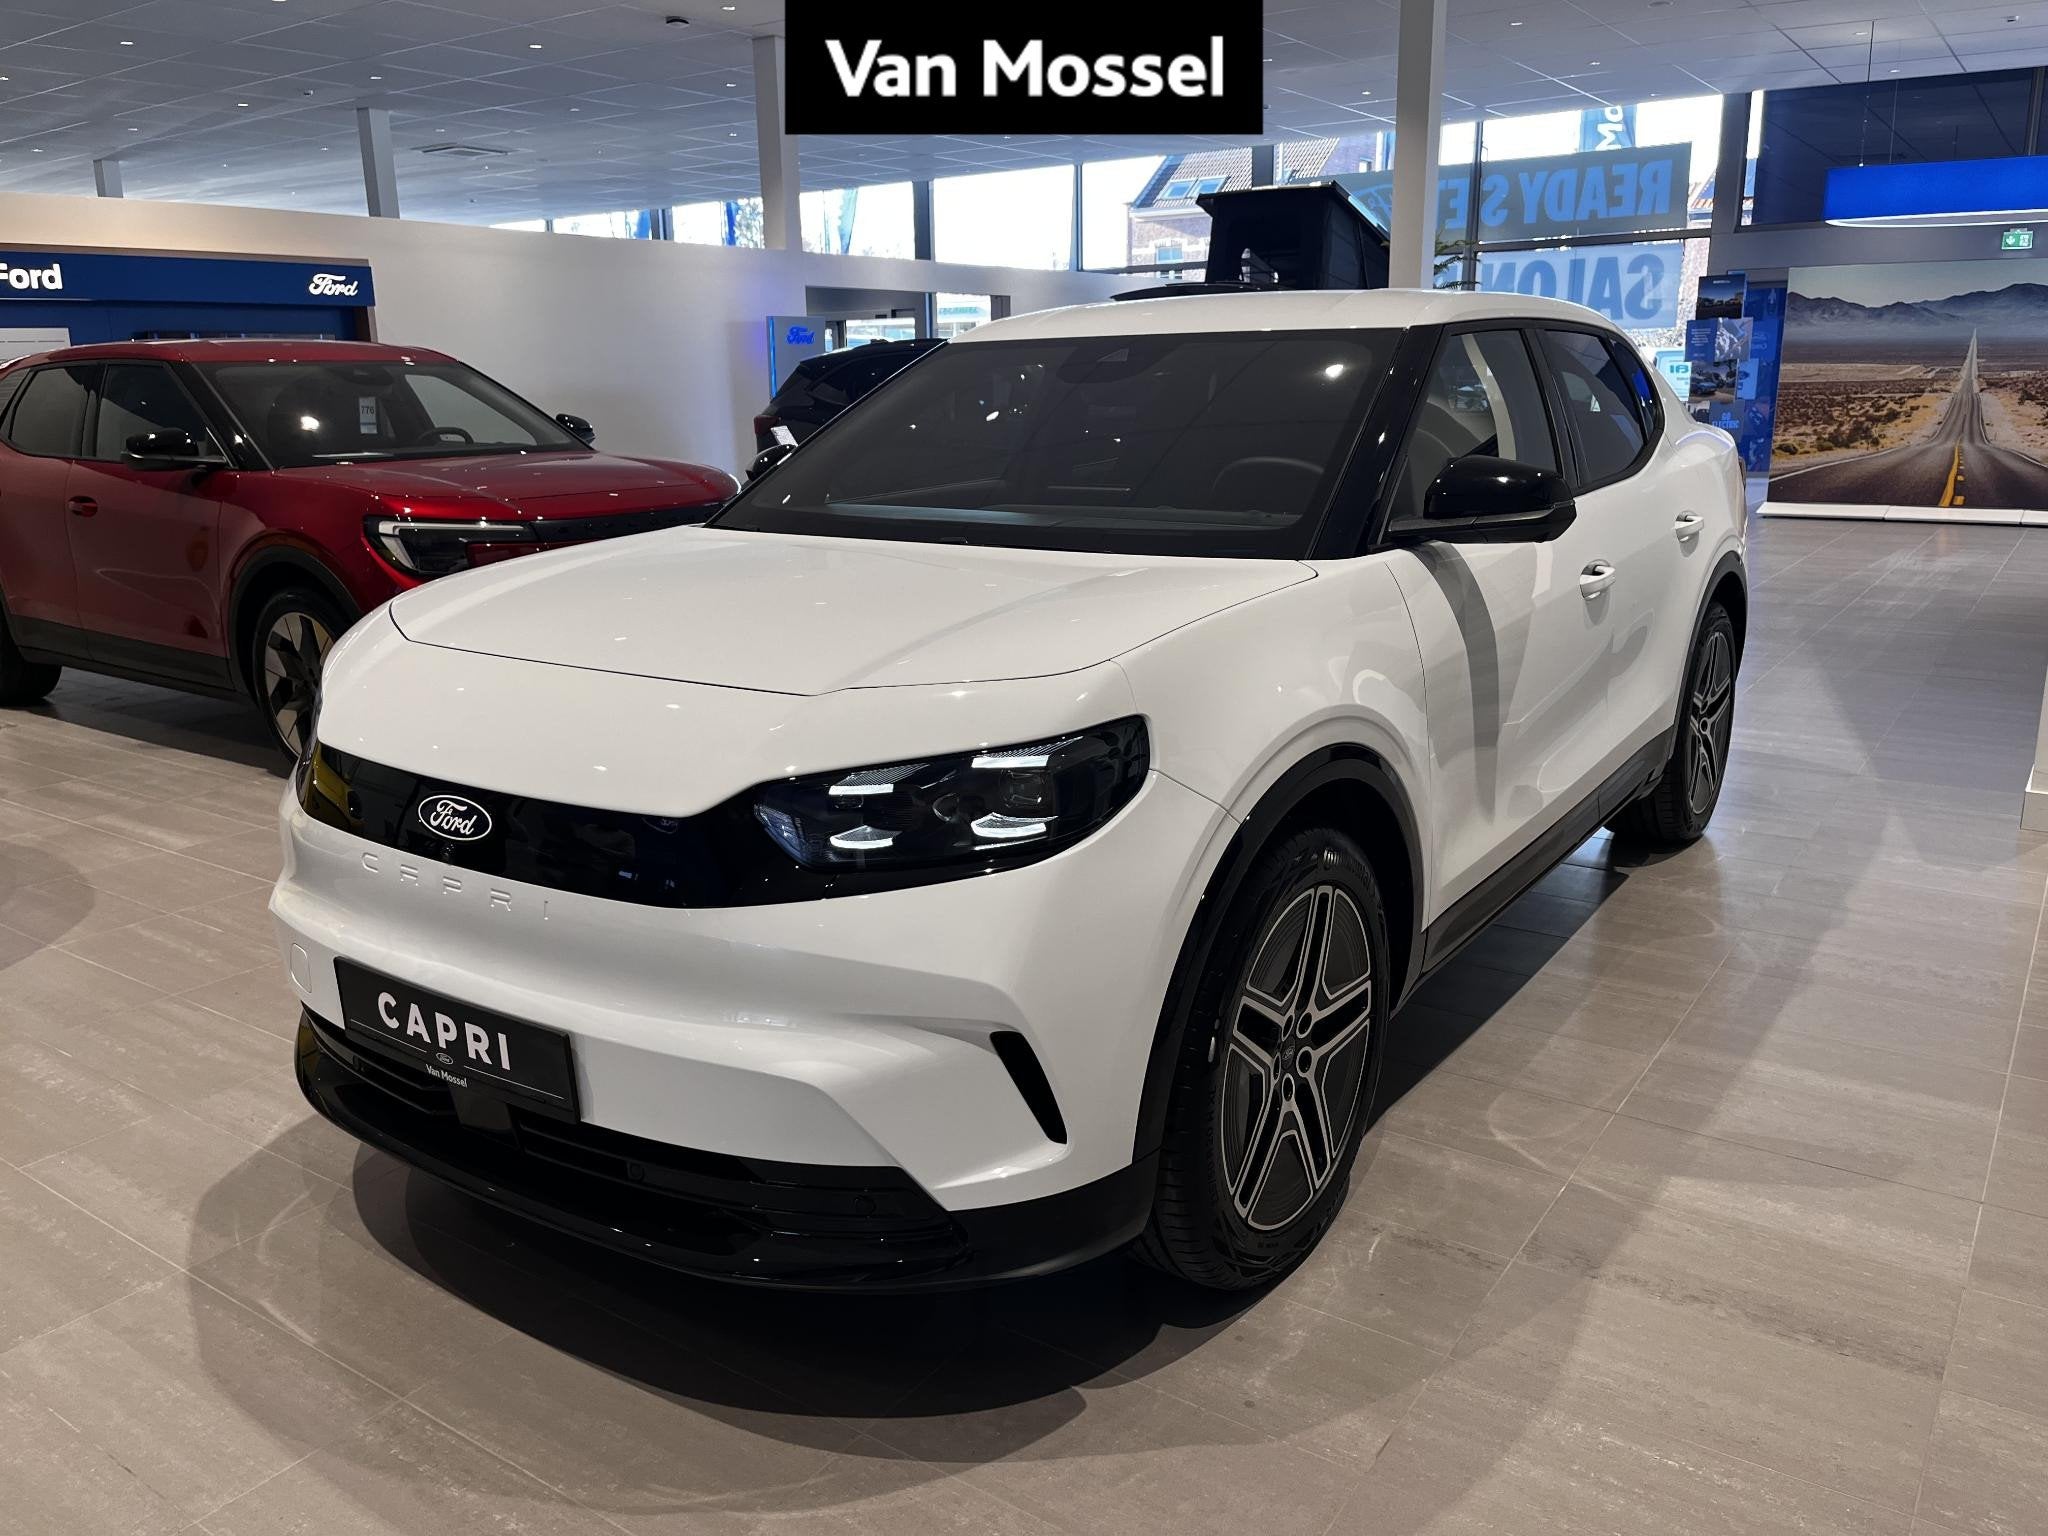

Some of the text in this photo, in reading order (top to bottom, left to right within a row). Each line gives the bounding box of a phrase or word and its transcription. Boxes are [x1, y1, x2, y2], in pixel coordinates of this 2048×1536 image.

[308, 273, 359, 297] Ford
[786, 325, 815, 345] Ford
[430, 798, 476, 838] Ford
[361, 851, 550, 921] CAPRI
[377, 991, 512, 1072] CAPRI
[425, 1063, 468, 1088] Van Mossel
